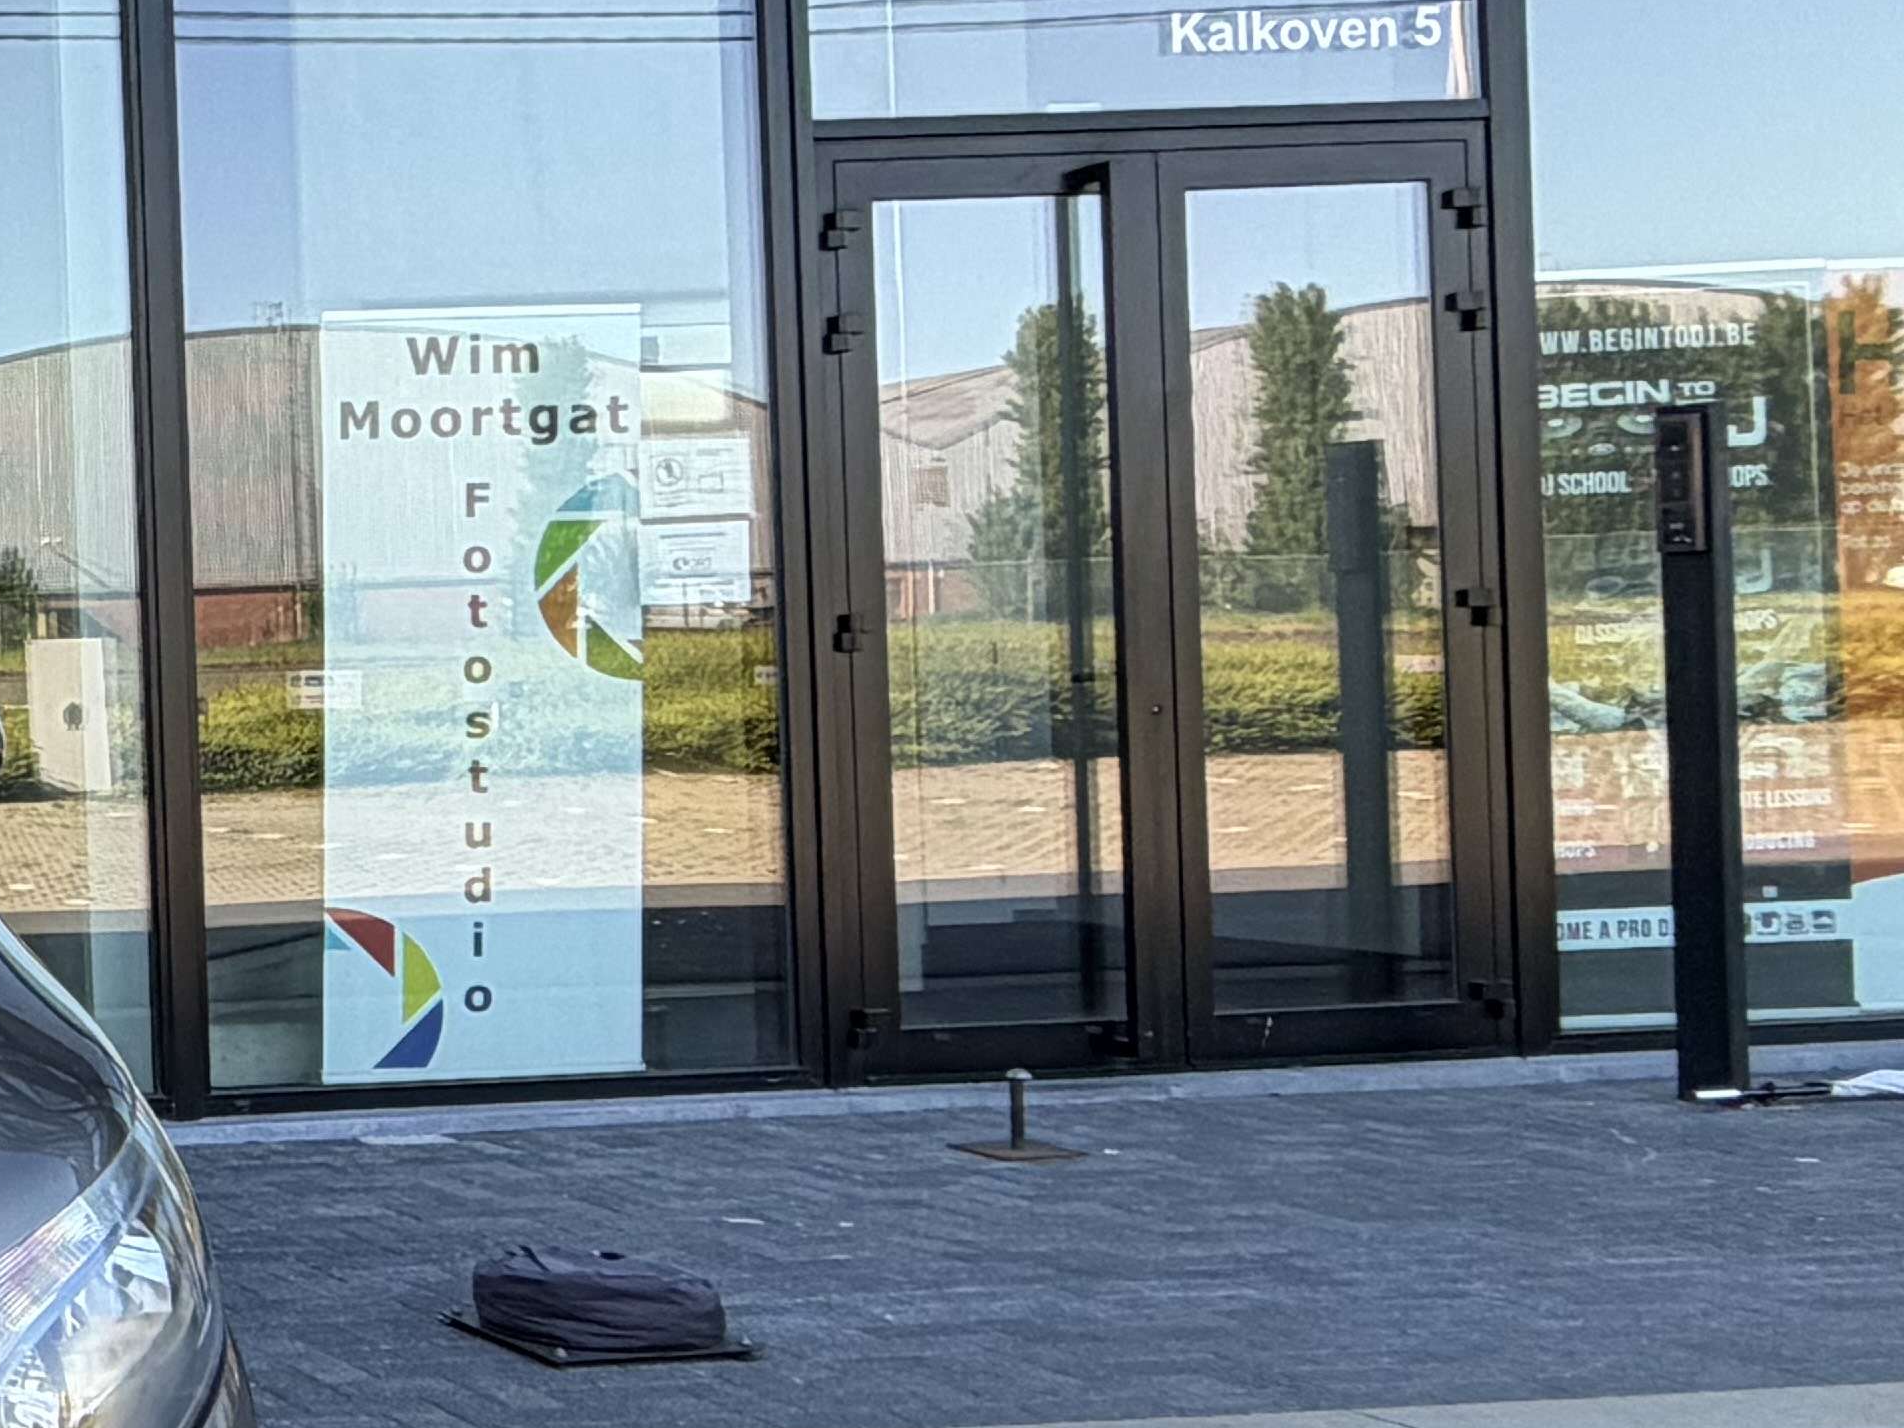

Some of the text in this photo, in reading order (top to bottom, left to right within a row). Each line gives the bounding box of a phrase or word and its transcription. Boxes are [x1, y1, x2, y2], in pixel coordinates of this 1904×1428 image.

[1170, 5, 1443, 56] Kalkoven 5
[405, 333, 540, 375] Wim
[1538, 378, 1716, 410] BEGIN TO
[339, 395, 632, 446] Moortgat
[1558, 470, 1632, 496] SCHOOL
